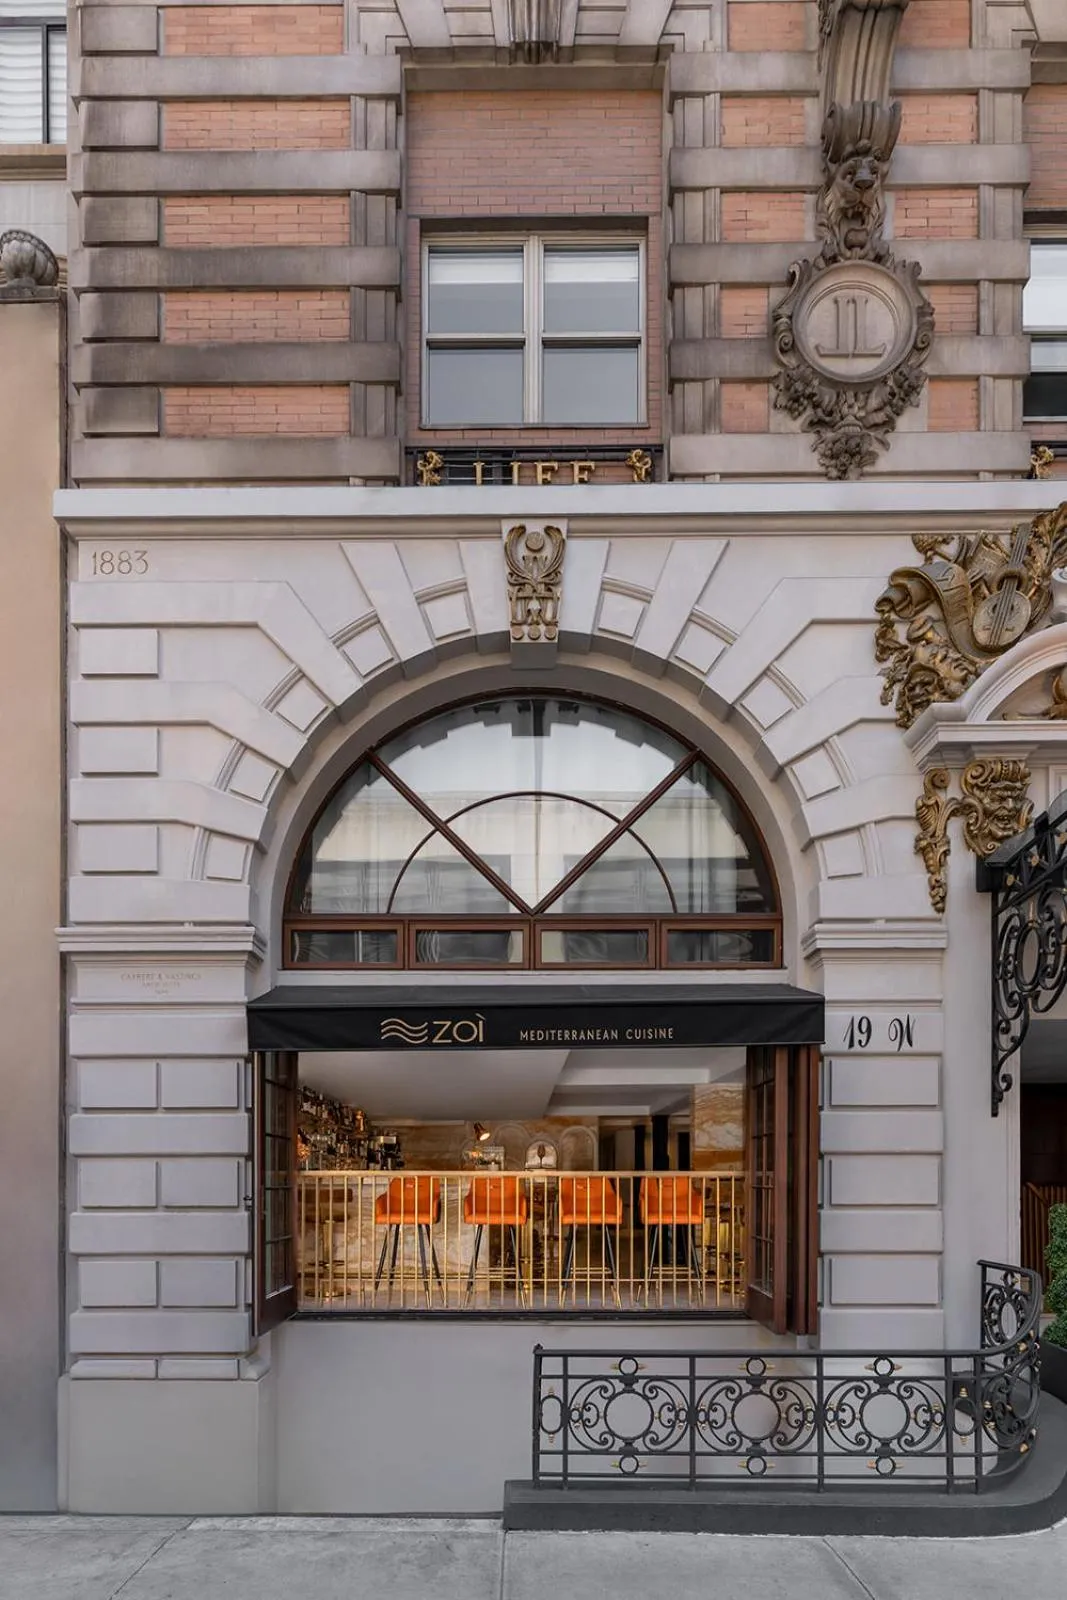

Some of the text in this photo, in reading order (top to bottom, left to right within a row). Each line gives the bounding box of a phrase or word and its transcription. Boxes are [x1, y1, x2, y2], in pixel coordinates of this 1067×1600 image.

[92, 550, 149, 575] 1883
[520, 1029, 619, 1041] MEDITERRANEAN
[626, 1027, 674, 1039] CUISINE
[842, 1016, 872, 1049] 19
